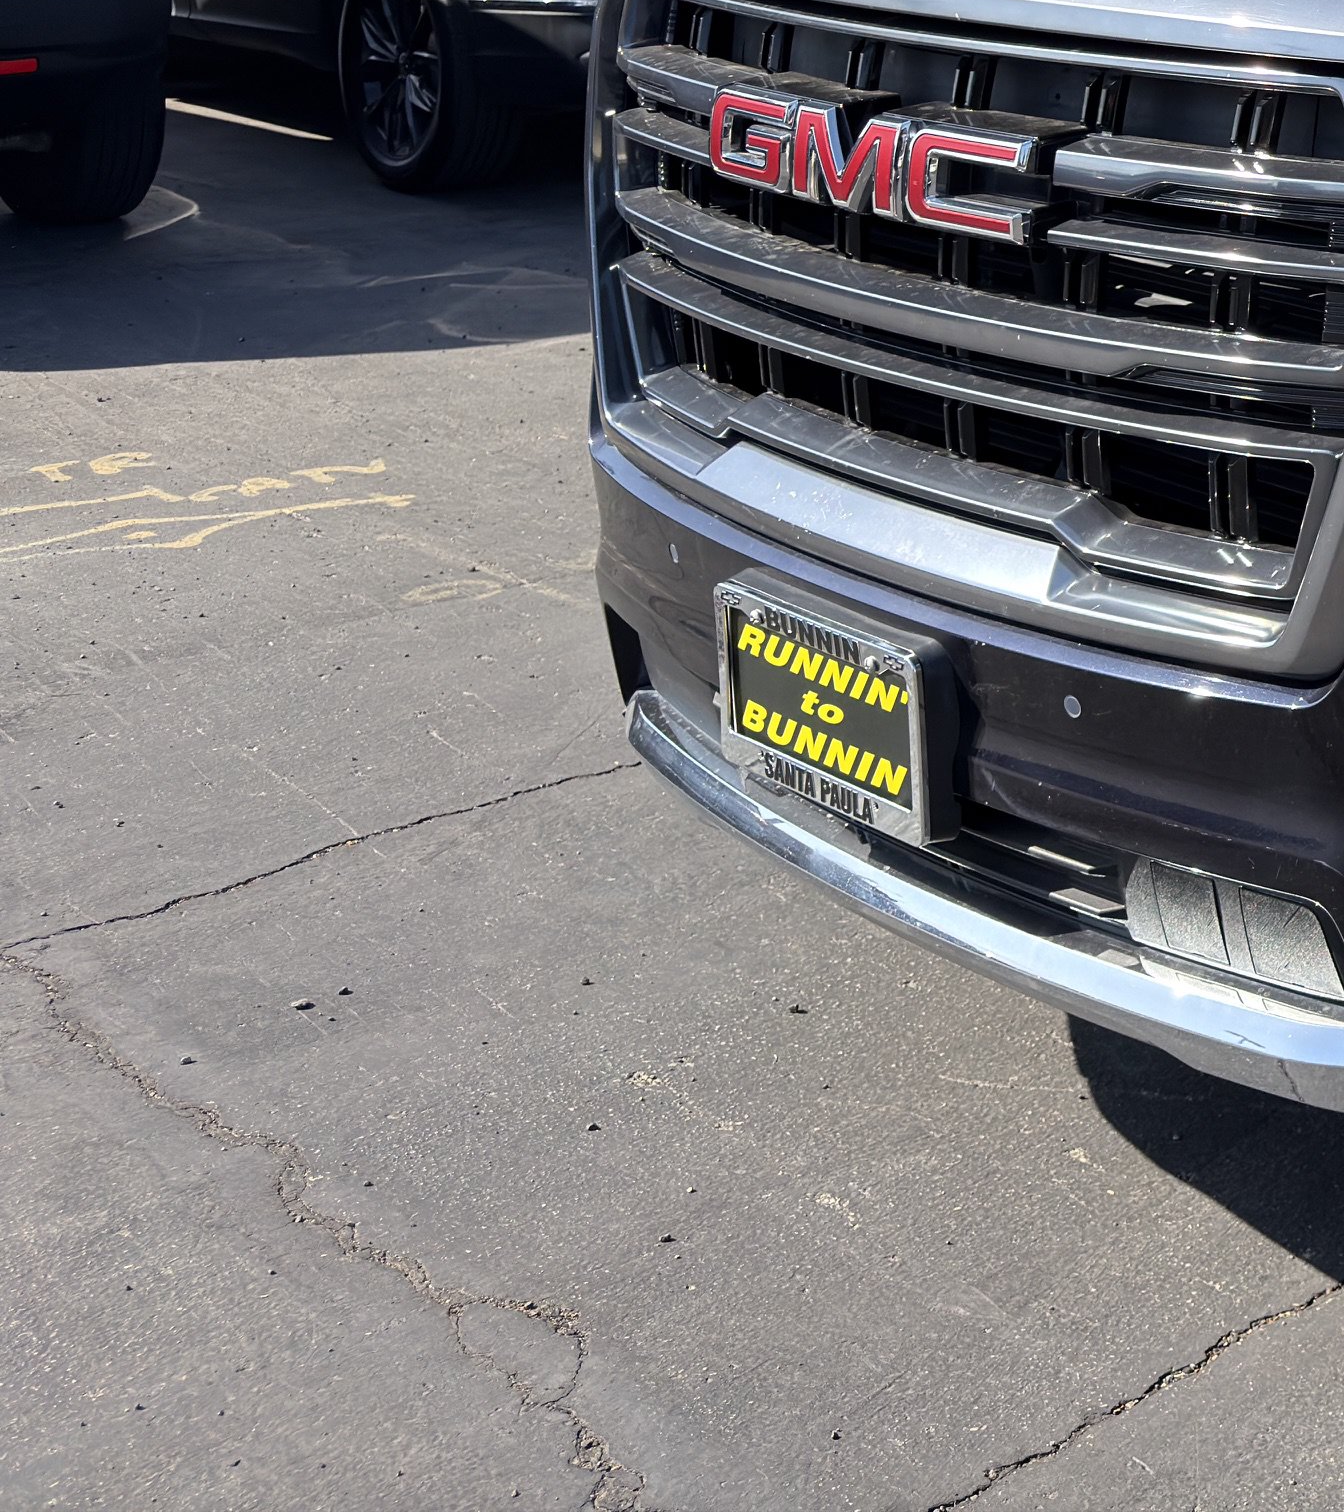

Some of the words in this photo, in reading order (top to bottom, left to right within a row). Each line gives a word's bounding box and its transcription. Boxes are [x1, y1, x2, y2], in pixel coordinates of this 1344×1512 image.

[708, 83, 1039, 246] GMC
[737, 624, 909, 713] RUNNIN'
[763, 605, 862, 667] BUNNIN
[742, 699, 908, 796] BUNNIN
[800, 690, 845, 725] to
[764, 753, 817, 799] SANTA
[820, 777, 875, 825] PAULA
